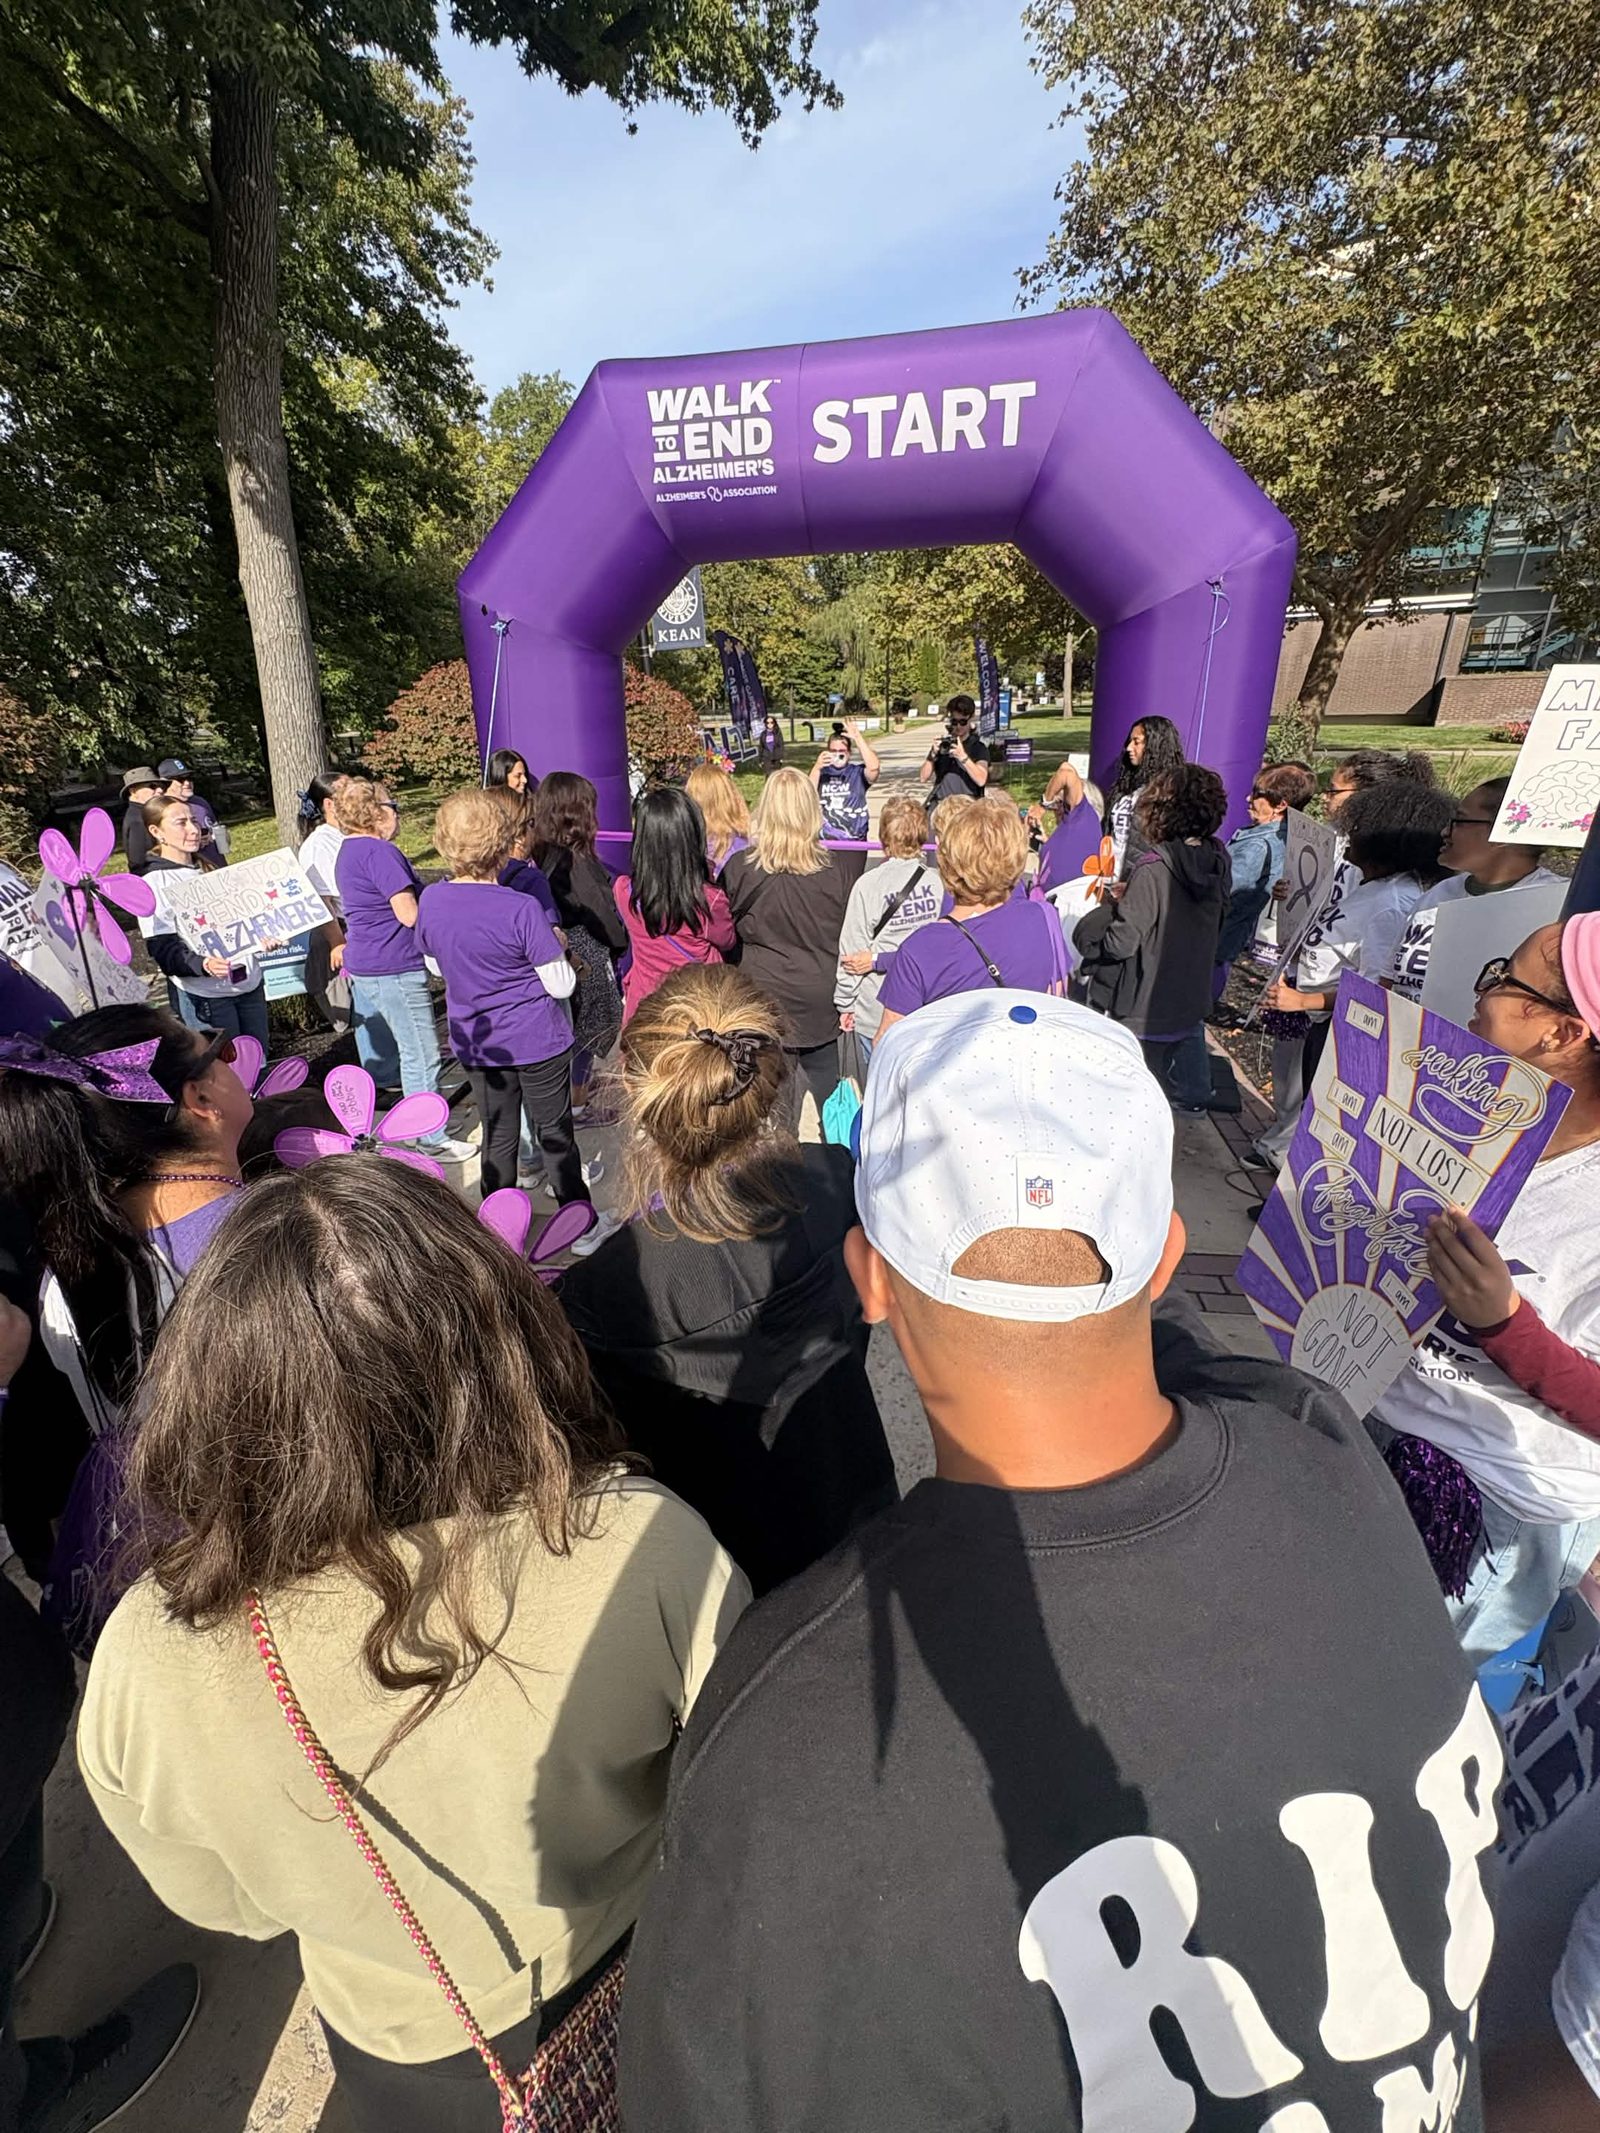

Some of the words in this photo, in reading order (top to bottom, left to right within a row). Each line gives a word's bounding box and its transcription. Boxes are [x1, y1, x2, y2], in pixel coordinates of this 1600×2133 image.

[812, 381, 1037, 464] START
[655, 437, 677, 451] TO
[684, 417, 773, 460] END
[653, 458, 775, 484] ALZHEIMER'S
[656, 491, 707, 503] ALZHEIMER'S
[723, 486, 777, 498] ASSOCIATION
[658, 627, 701, 643] KEAN
[727, 667, 741, 704] CARE
[979, 638, 991, 709] WELCOME
[169, 870, 241, 910] WALK
[237, 855, 290, 885] TO
[206, 888, 267, 924] END
[902, 898, 936, 917] END
[7, 917, 21, 927] TO
[1363, 1013, 1378, 1030] am
[1341, 1092, 1358, 1111] am
[1402, 1046, 1547, 1144] seeking
[1331, 1132, 1350, 1155] am
[1374, 1107, 1417, 1153] NOT
[1029, 1189, 1051, 1205] NFL
[1395, 1289, 1411, 1310] am
[1336, 1292, 1397, 1370] NOT
[1303, 1319, 1367, 1391] GONE
